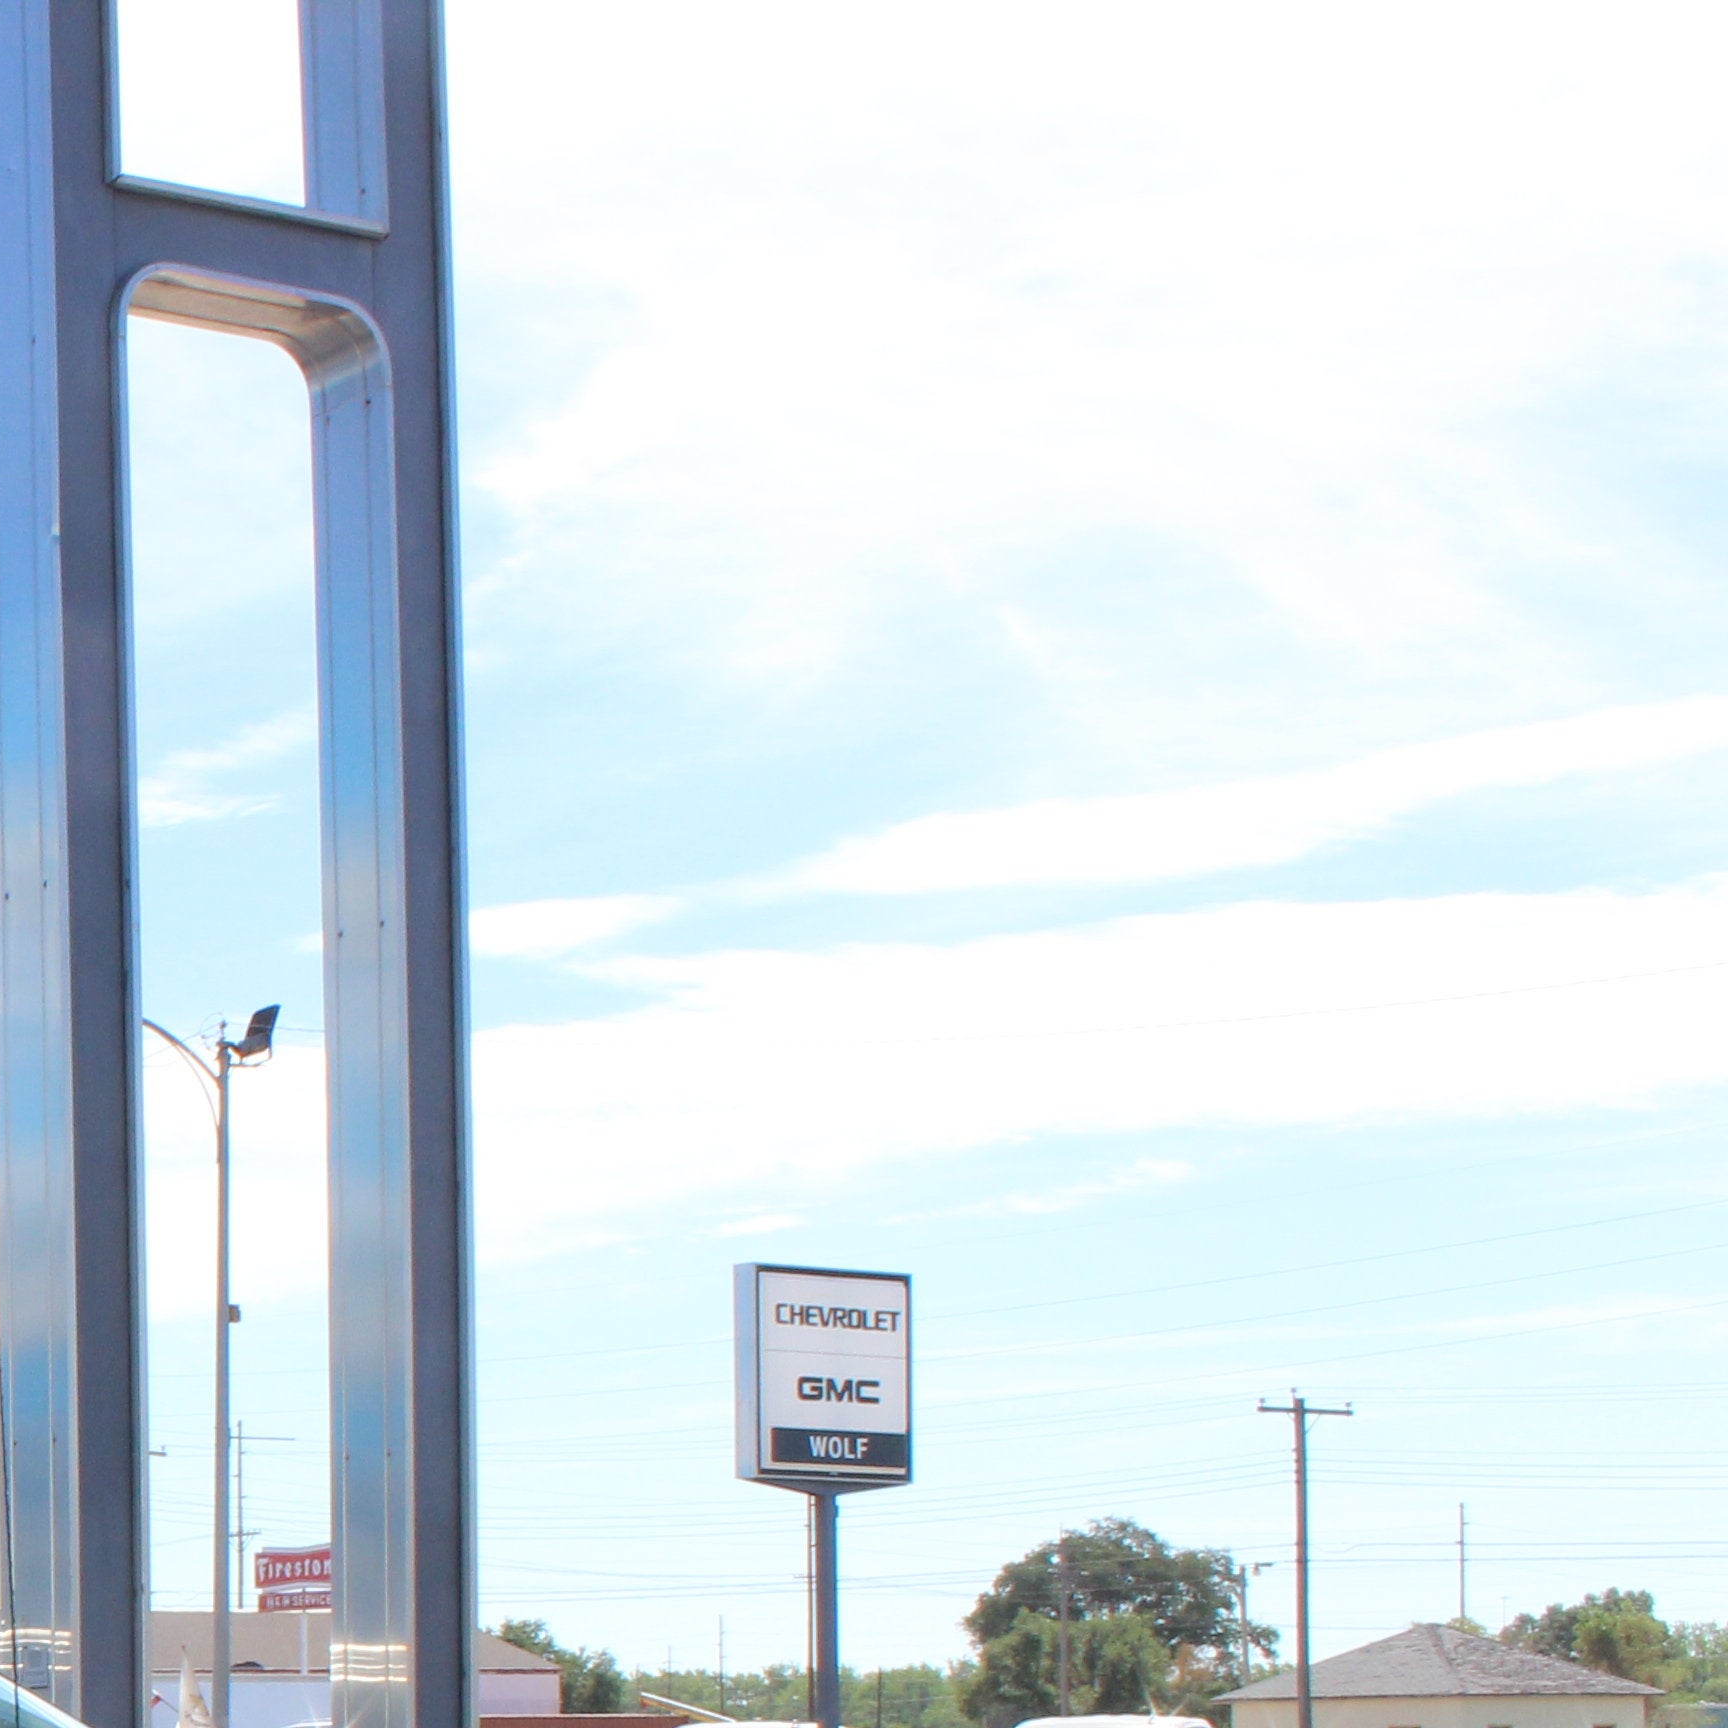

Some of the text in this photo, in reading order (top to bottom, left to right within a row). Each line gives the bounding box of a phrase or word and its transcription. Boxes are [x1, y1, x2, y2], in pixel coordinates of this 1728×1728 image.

[775, 1303, 900, 1332] CHEVROLET
[798, 1376, 880, 1404] GMC
[809, 1435, 869, 1459] WOLF
[257, 1557, 332, 1582] Fireston
